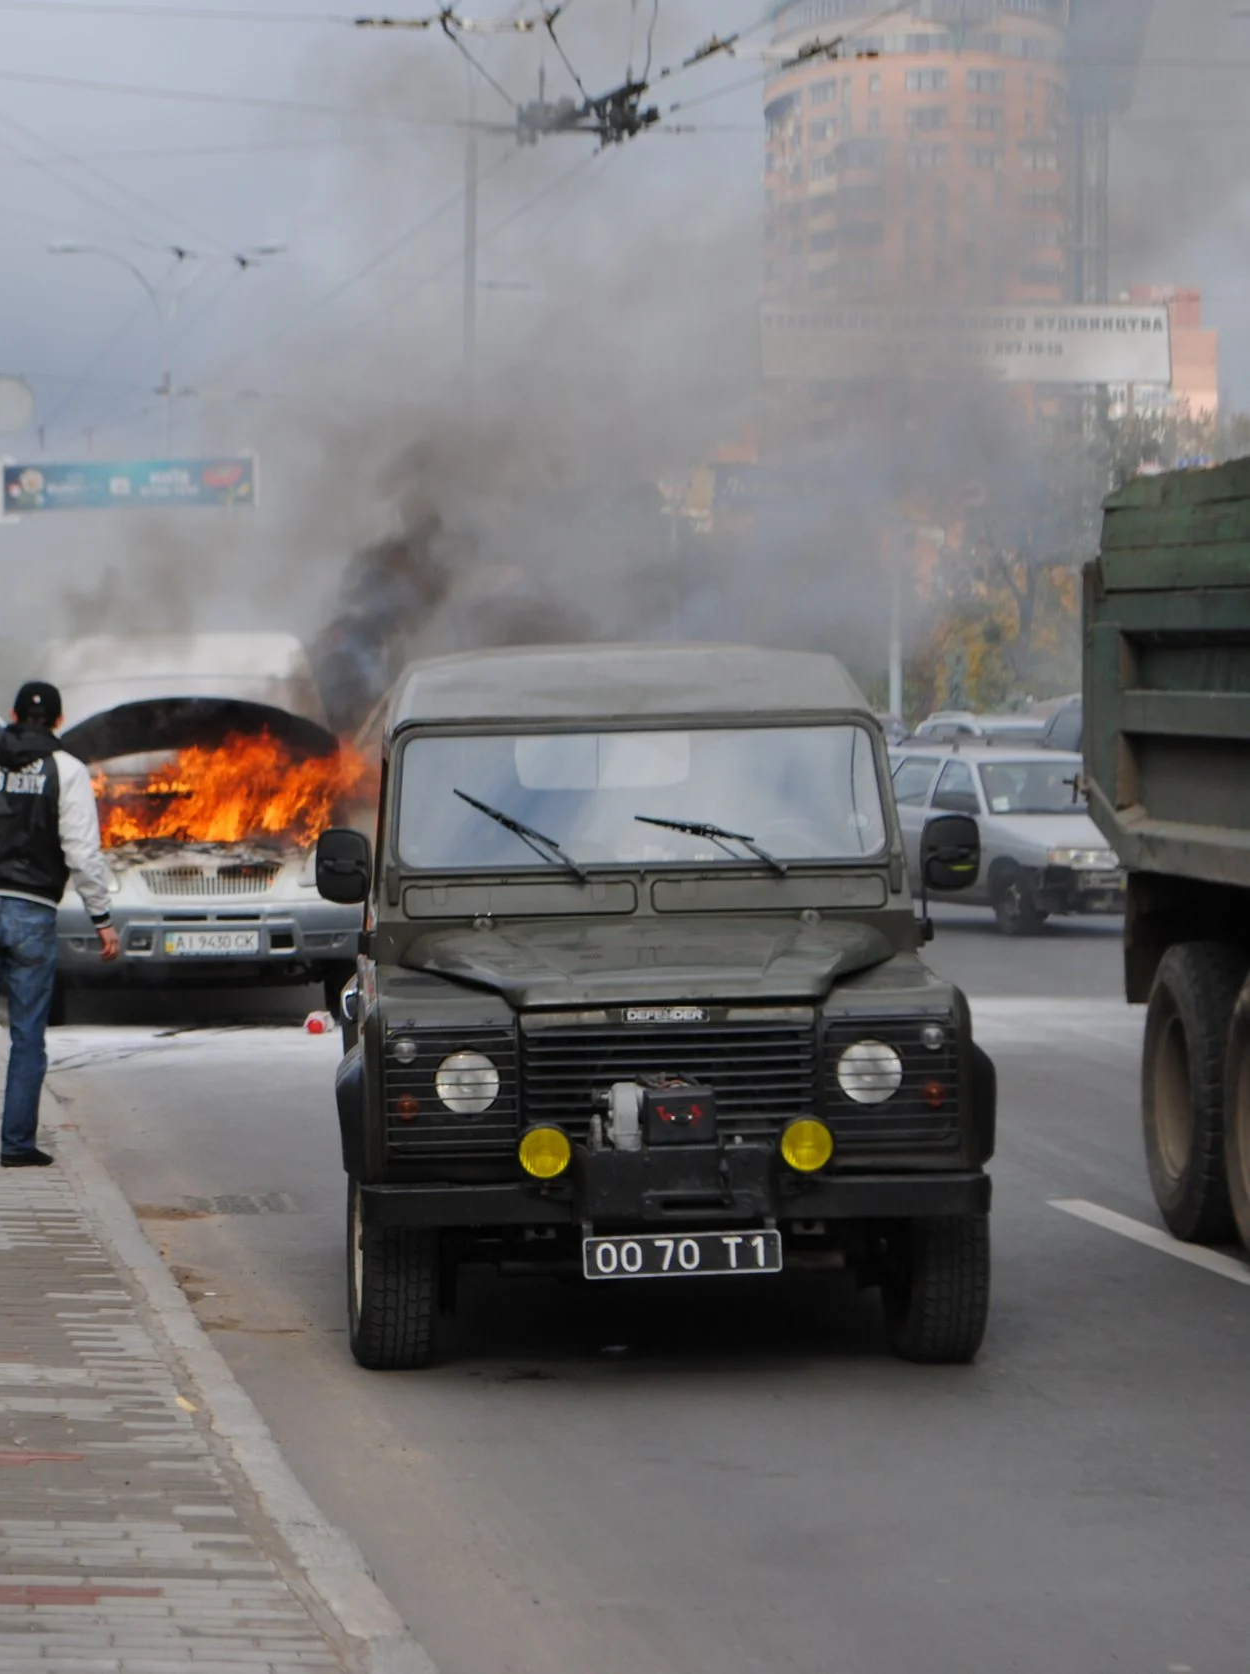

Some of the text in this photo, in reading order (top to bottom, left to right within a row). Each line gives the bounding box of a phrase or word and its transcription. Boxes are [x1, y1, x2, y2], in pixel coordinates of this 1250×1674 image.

[198, 934, 232, 949] 9430
[234, 933, 255, 949] CK
[626, 1009, 704, 1021] DEFENDER
[654, 1238, 701, 1271] 70
[721, 1235, 766, 1269] T1
